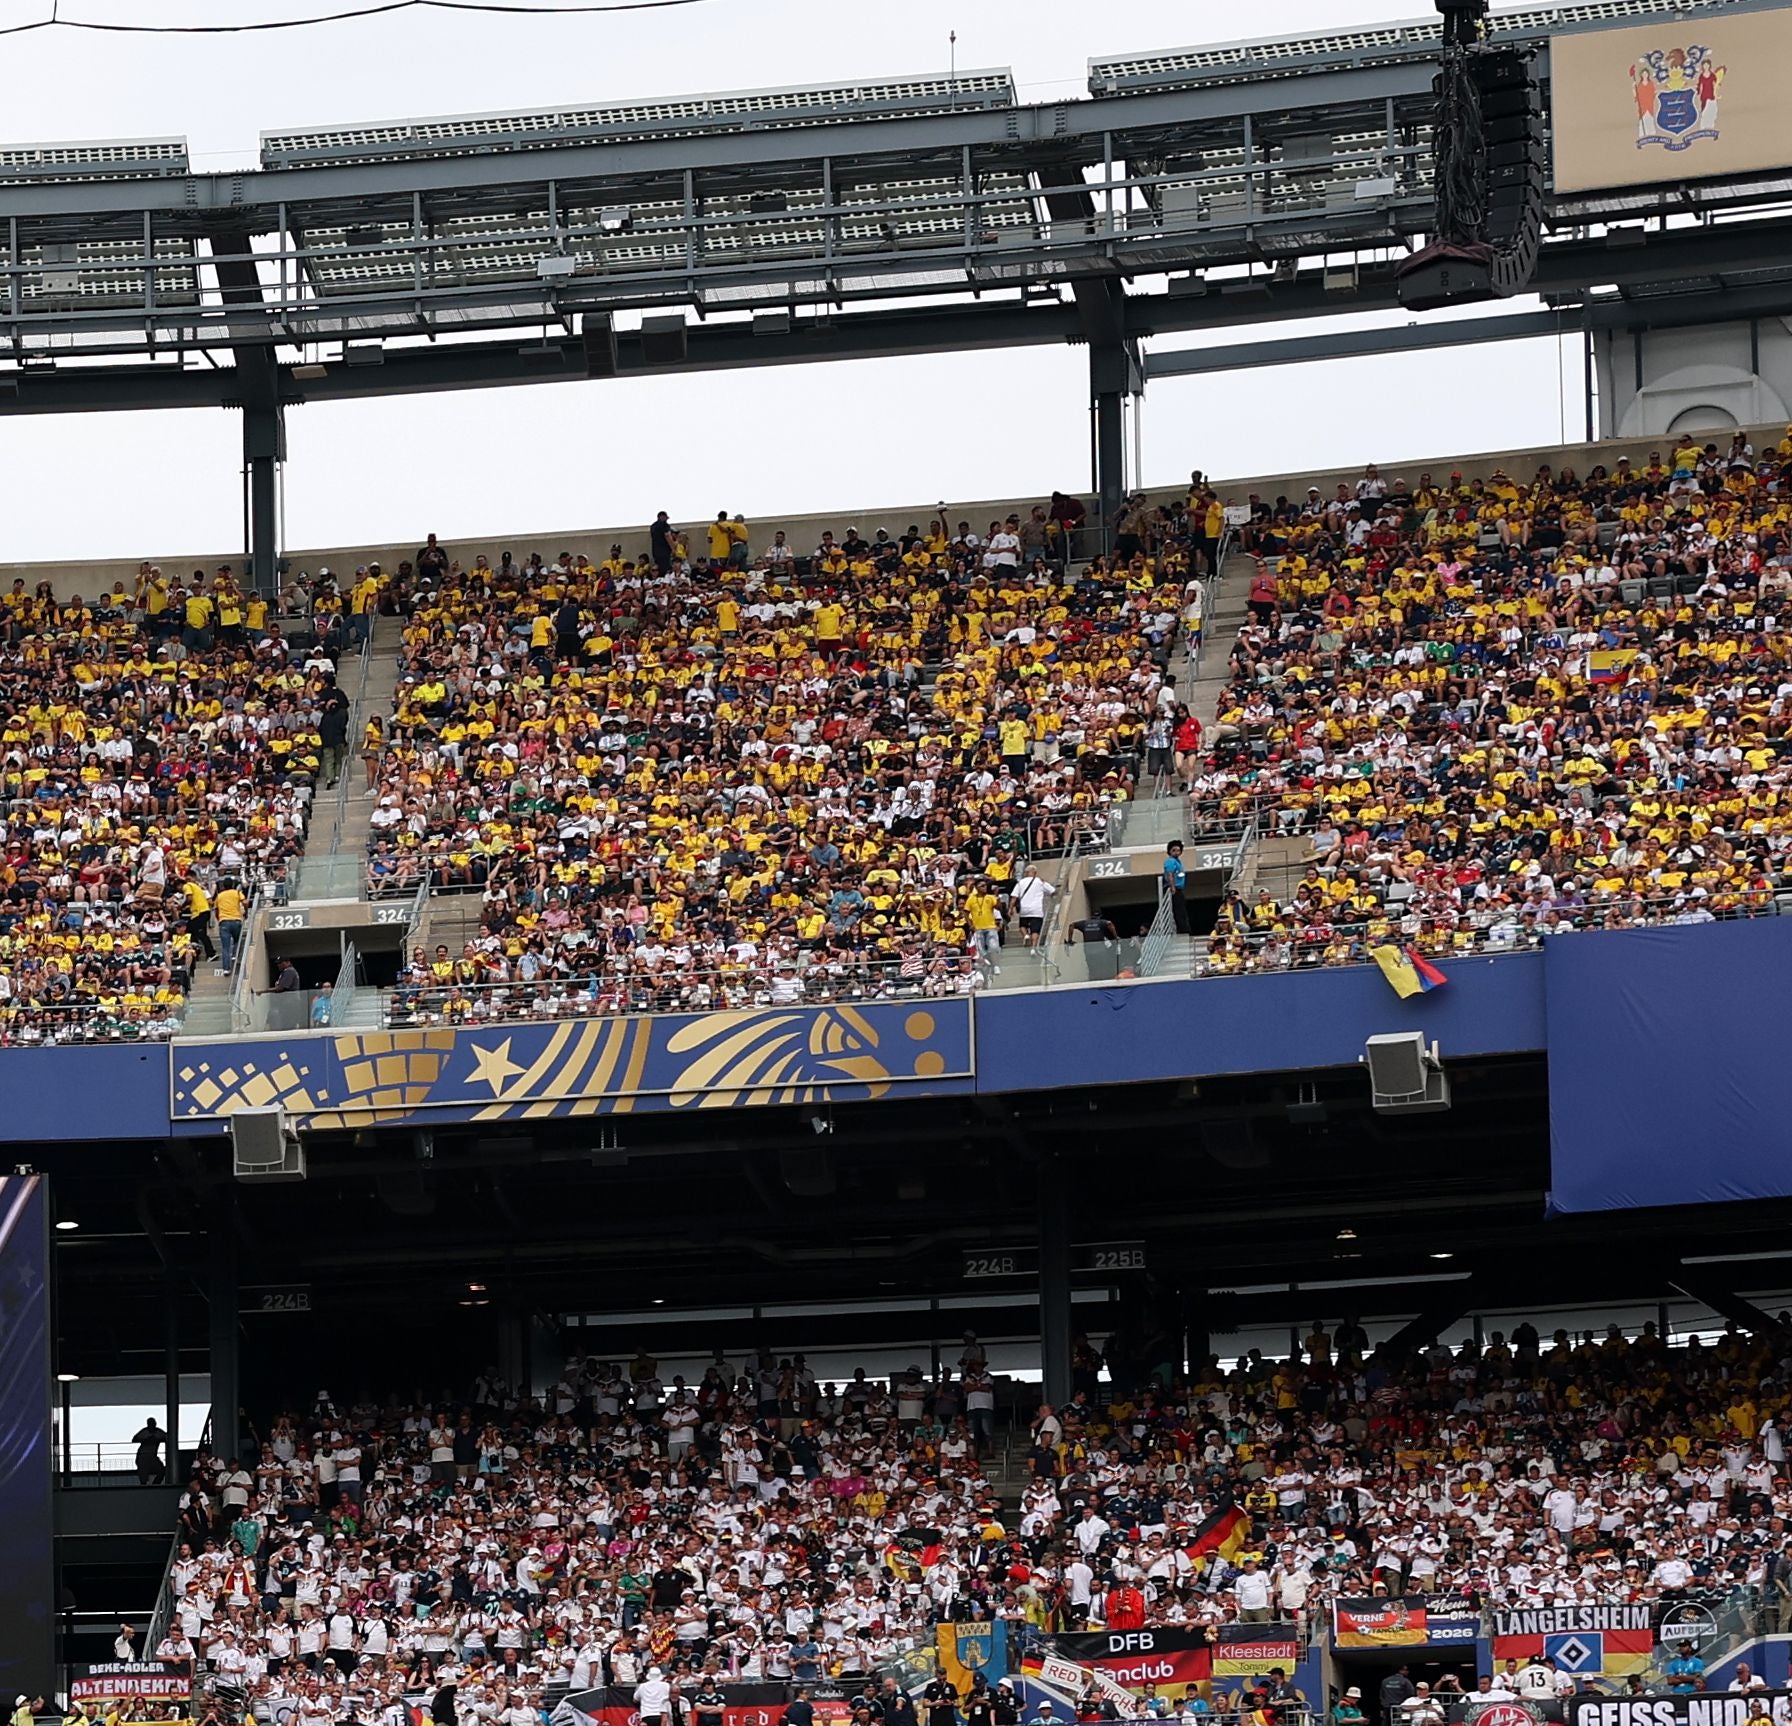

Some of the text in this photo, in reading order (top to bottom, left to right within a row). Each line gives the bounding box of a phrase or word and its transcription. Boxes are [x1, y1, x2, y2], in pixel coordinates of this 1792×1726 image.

[1202, 853, 1232, 868] 325
[1095, 863, 1124, 877] 324
[275, 915, 303, 928] 323
[377, 909, 406, 924] 324
[1349, 1613, 1384, 1623] VERNE
[1497, 1607, 1649, 1636] LANGELSHEIM
[1432, 1628, 1473, 1639] 2026
[1108, 1633, 1154, 1654] DFB
[1219, 1646, 1291, 1658] Kleestadt
[1048, 1664, 1077, 1683] RED
[1093, 1664, 1173, 1685] Fanclub
[1529, 1672, 1545, 1687] 13
